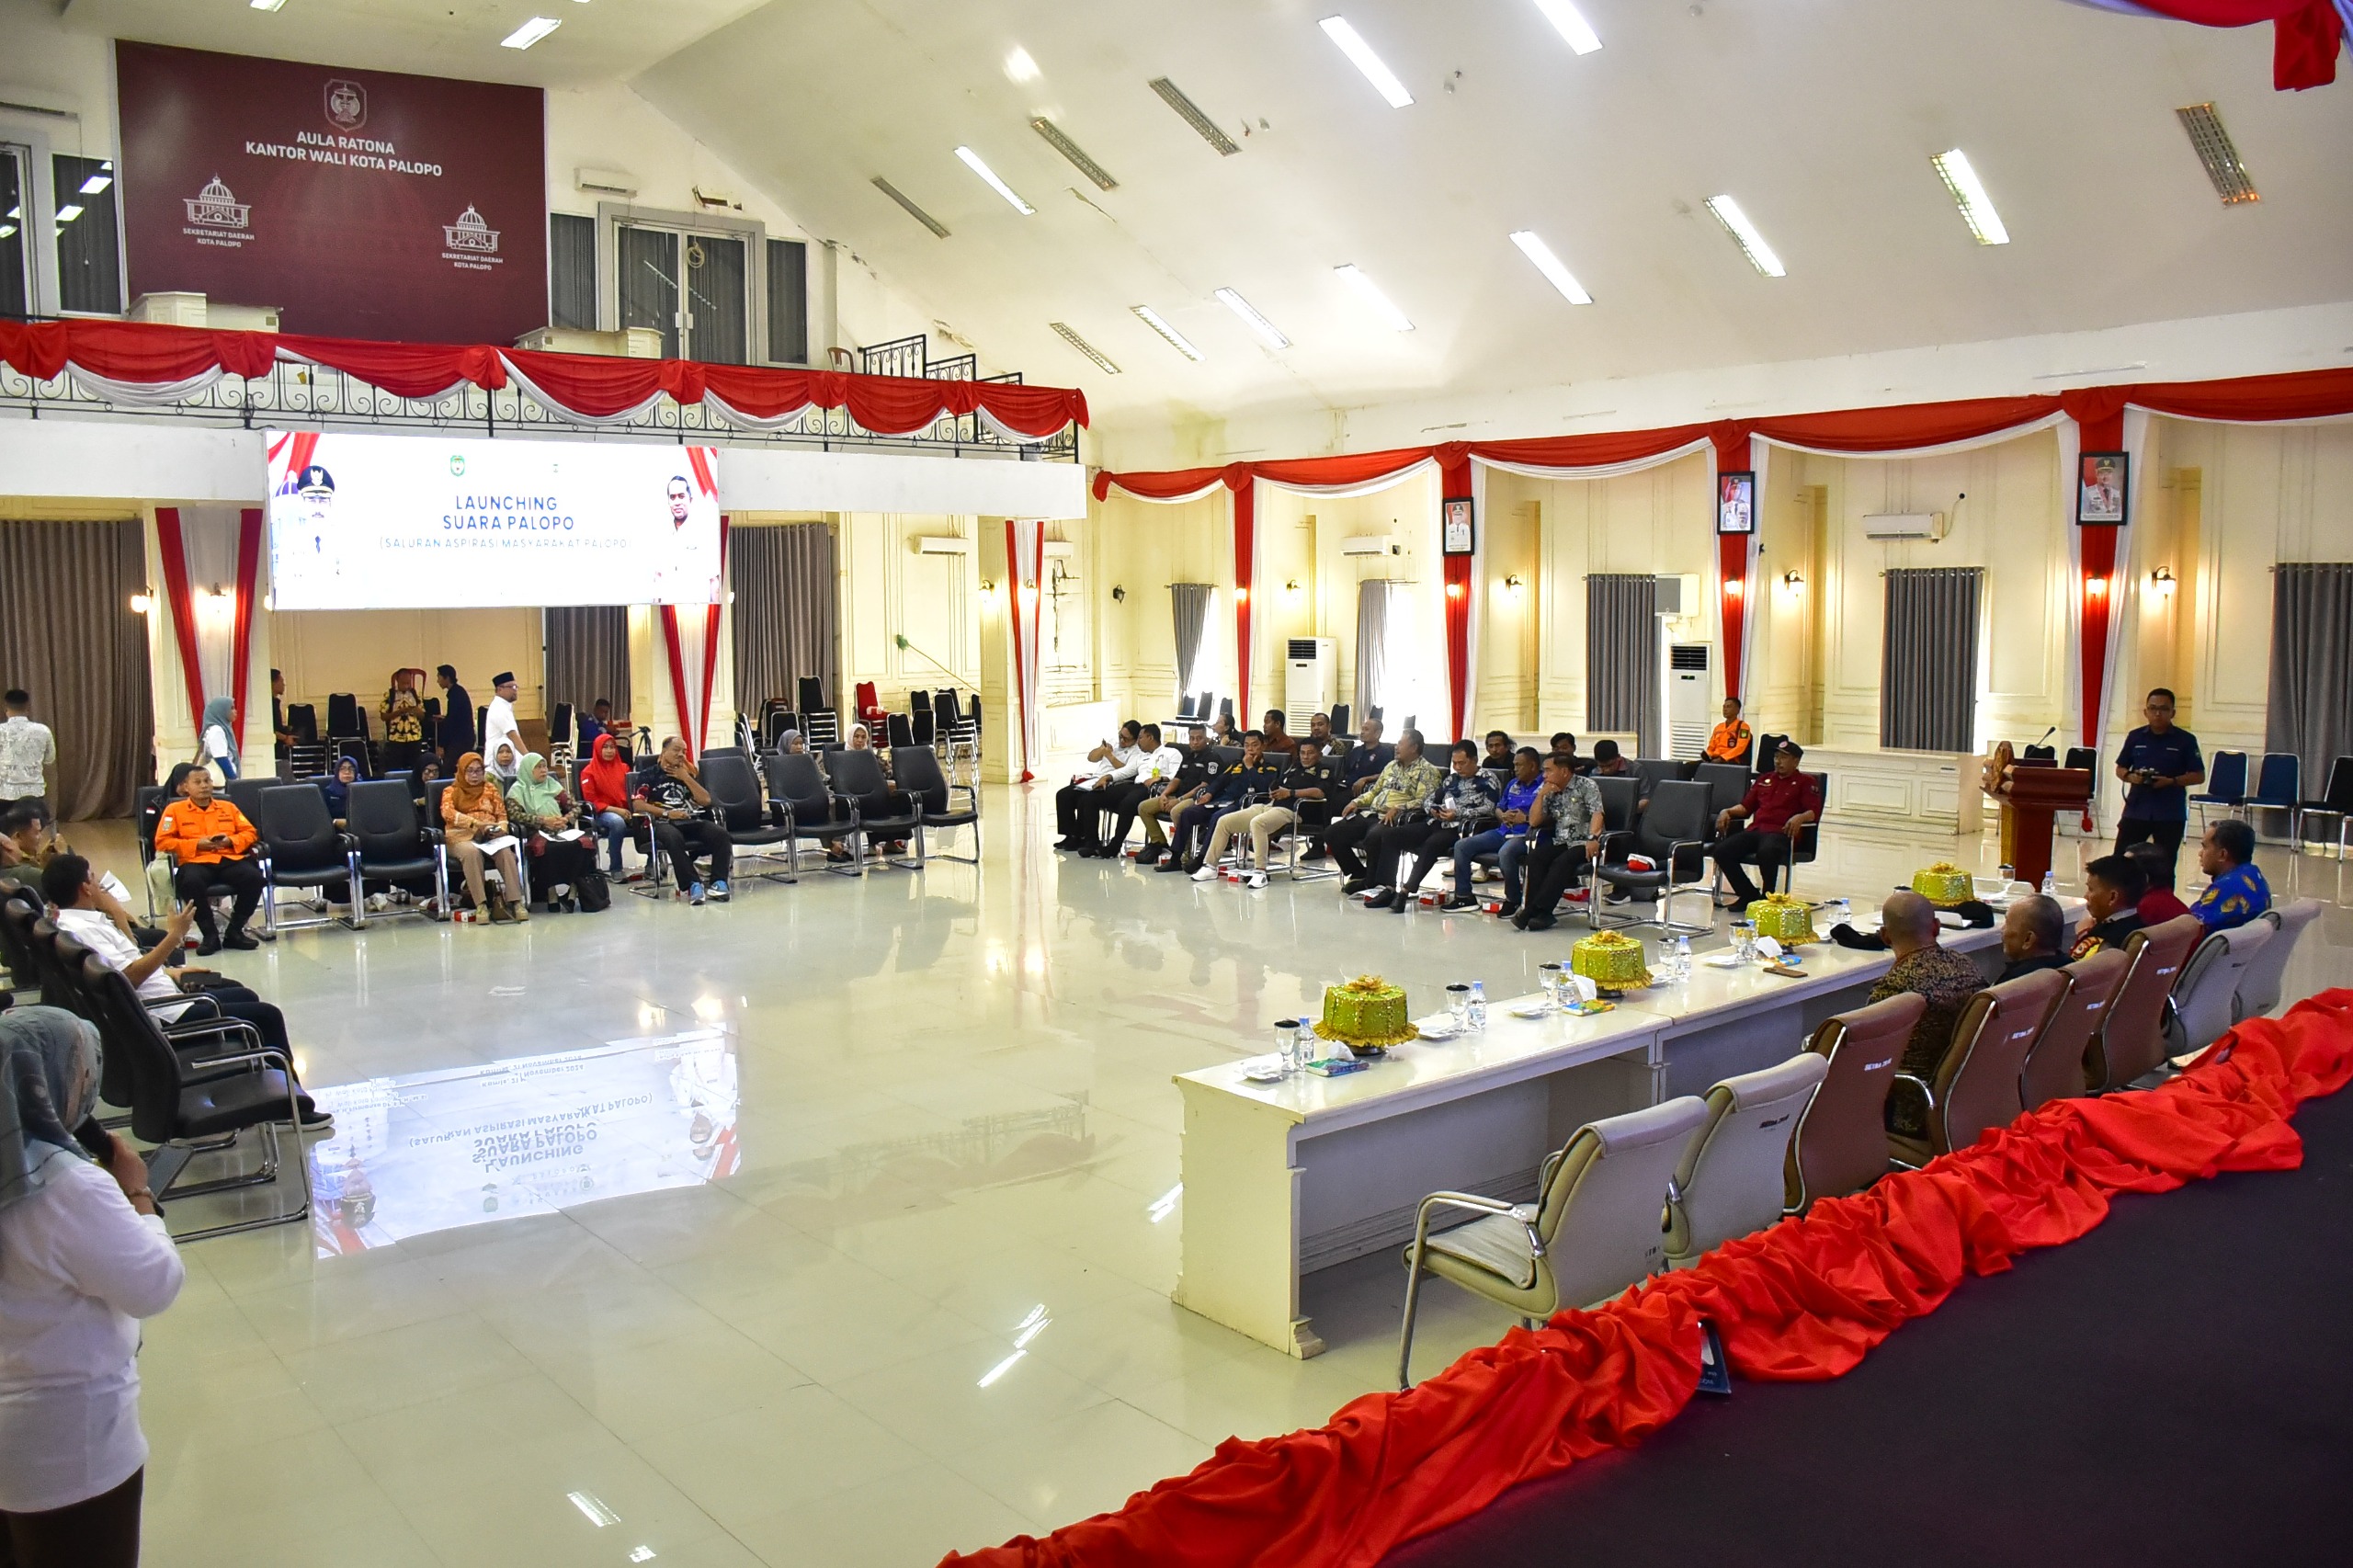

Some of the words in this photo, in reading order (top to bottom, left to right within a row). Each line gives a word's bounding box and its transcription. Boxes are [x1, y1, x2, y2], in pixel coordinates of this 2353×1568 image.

[297, 131, 335, 148] AULA
[338, 136, 394, 154] RATONA
[246, 142, 306, 160] KANTOR
[309, 149, 347, 165] WALI
[350, 153, 385, 170] KOTA
[389, 159, 442, 176] PALOPO
[184, 228, 227, 237] SEKRETARIAT
[216, 239, 242, 247] PALOPO
[442, 253, 480, 261] SEKRETARIAT
[481, 256, 504, 264] DAERAH
[457, 495, 557, 510] LAUNCHING
[443, 516, 502, 529] SUARA
[508, 516, 574, 530] PALOPO
[380, 538, 440, 549] (SALURAN
[446, 539, 498, 548] ASPIRASI
